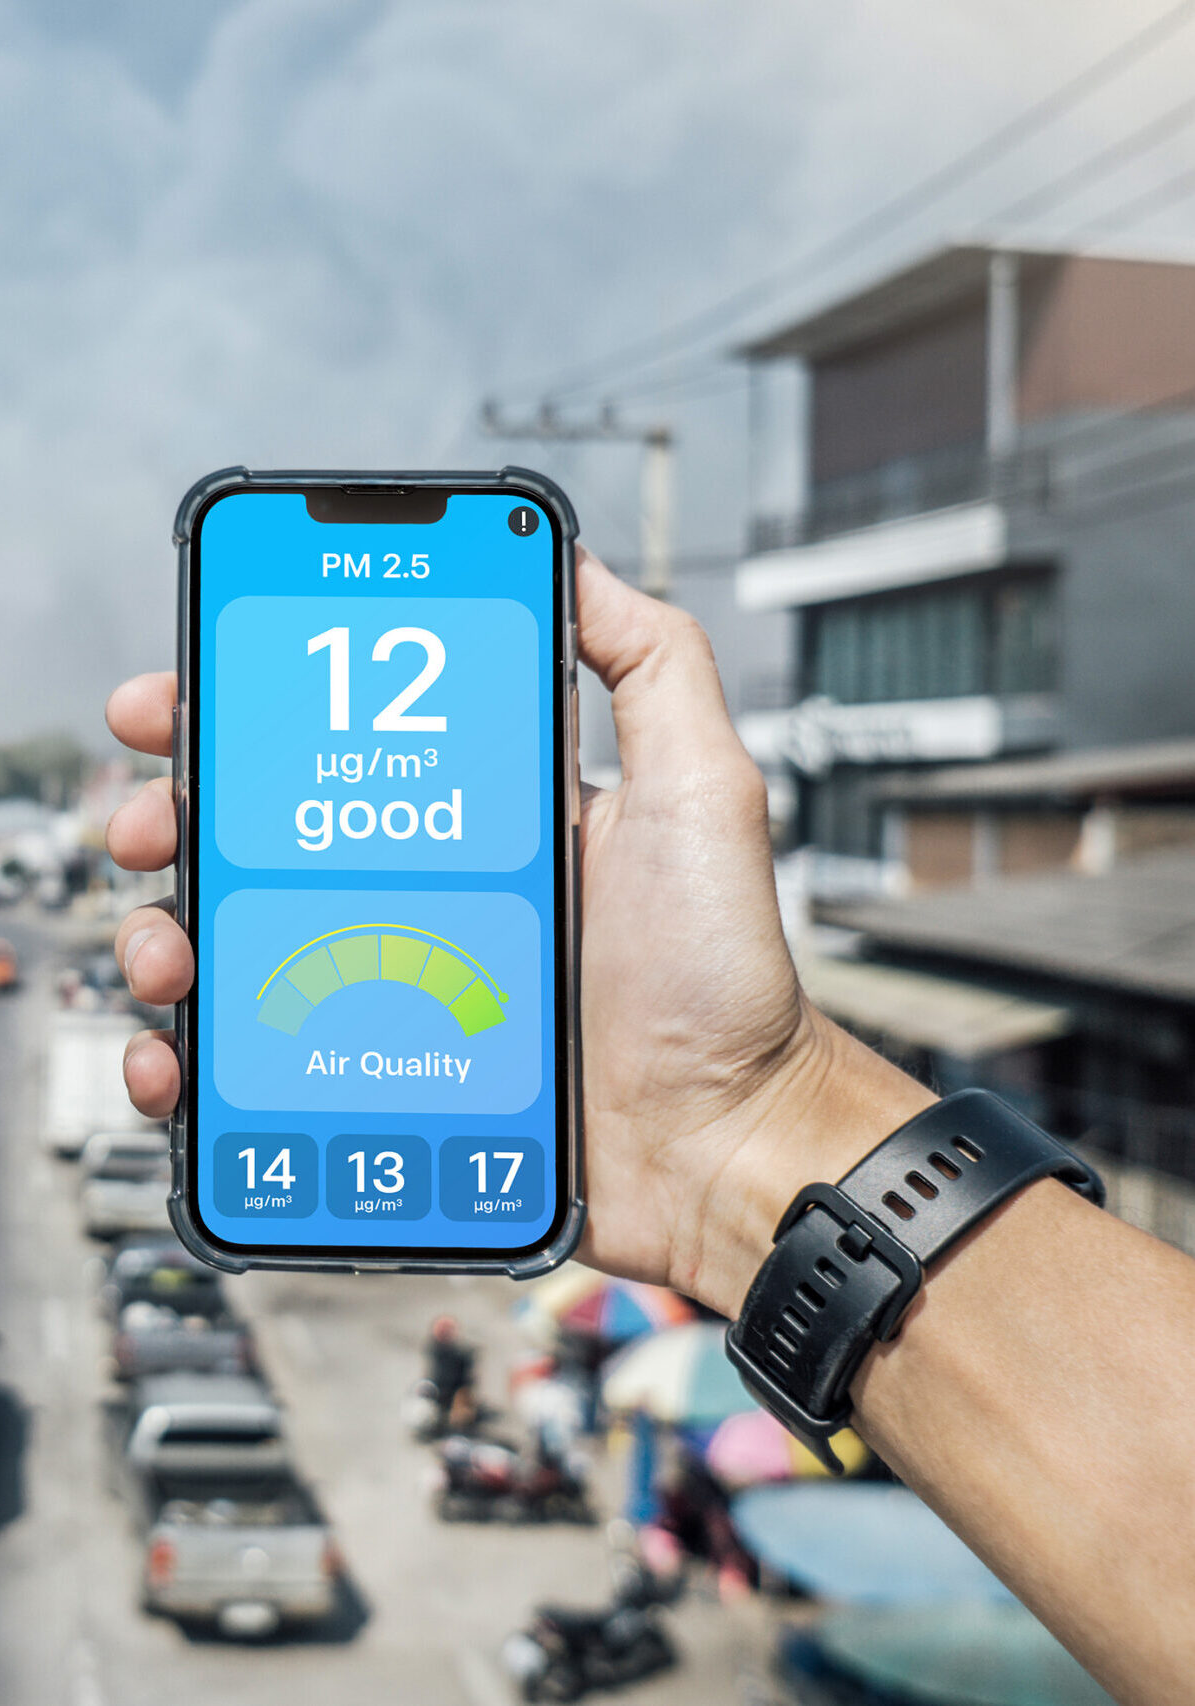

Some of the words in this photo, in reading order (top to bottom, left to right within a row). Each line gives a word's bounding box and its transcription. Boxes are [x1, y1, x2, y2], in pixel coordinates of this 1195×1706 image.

[322, 552, 371, 578] PM
[382, 553, 430, 579] 2.5
[307, 626, 447, 732] 12
[295, 788, 463, 852] good
[305, 1050, 350, 1075] Air
[360, 1051, 472, 1084] Quality
[238, 1147, 296, 1190] 14
[347, 1151, 405, 1194] 13
[469, 1151, 524, 1194] 17
